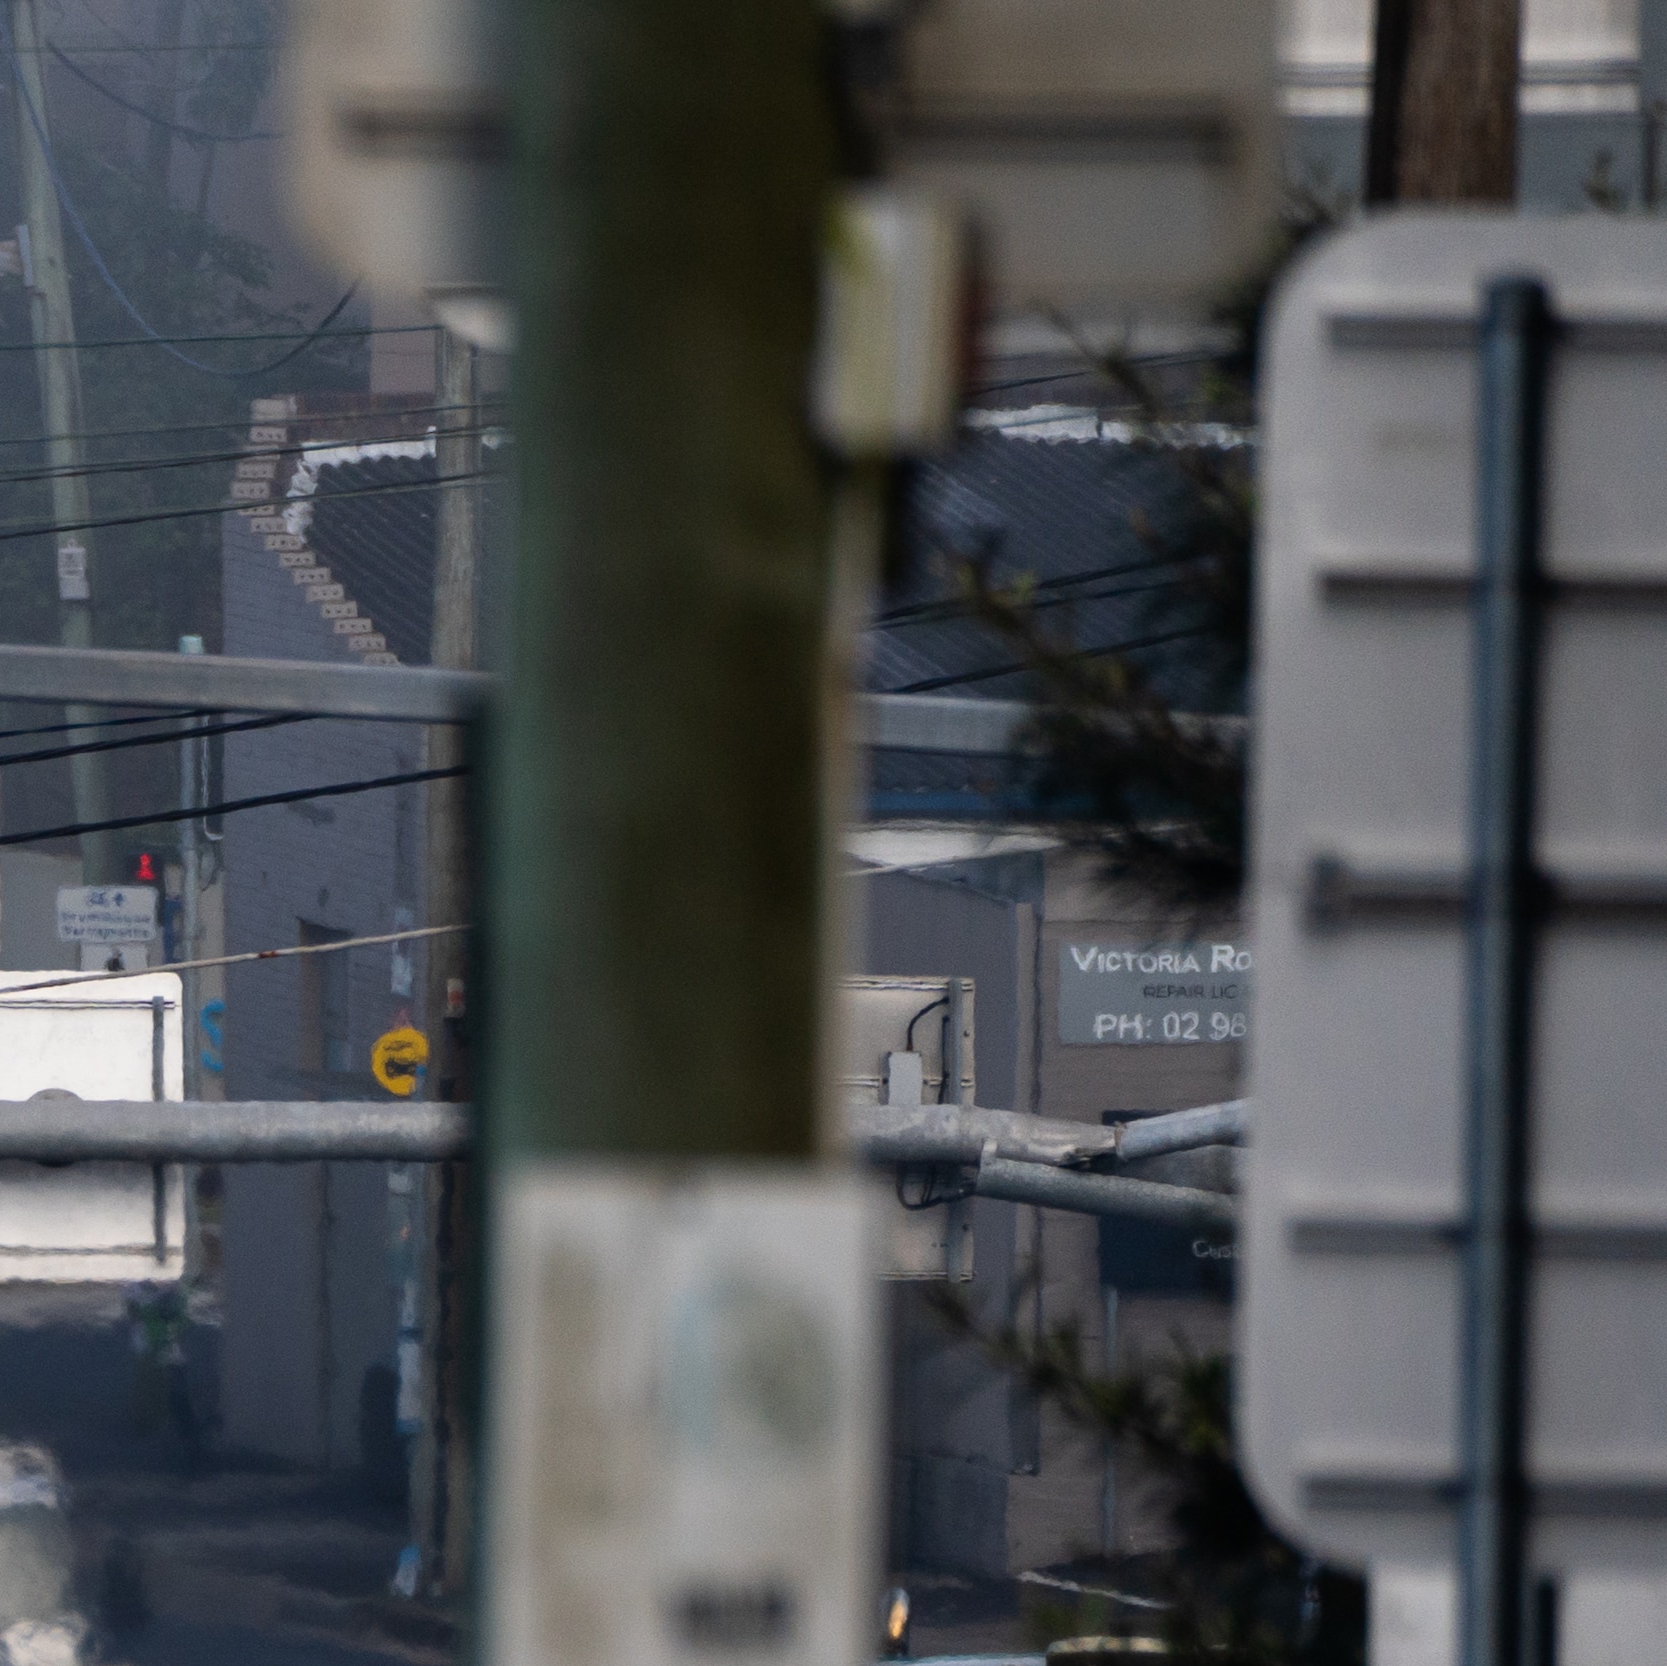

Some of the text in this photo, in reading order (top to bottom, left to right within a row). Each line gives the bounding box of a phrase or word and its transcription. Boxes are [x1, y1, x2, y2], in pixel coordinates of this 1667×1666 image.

[1070, 946, 1201, 974] VICTORIA
[1143, 985, 1204, 999] REPAIR
[1094, 1012, 1153, 1040] PH:
[1162, 1011, 1200, 1041] 02
